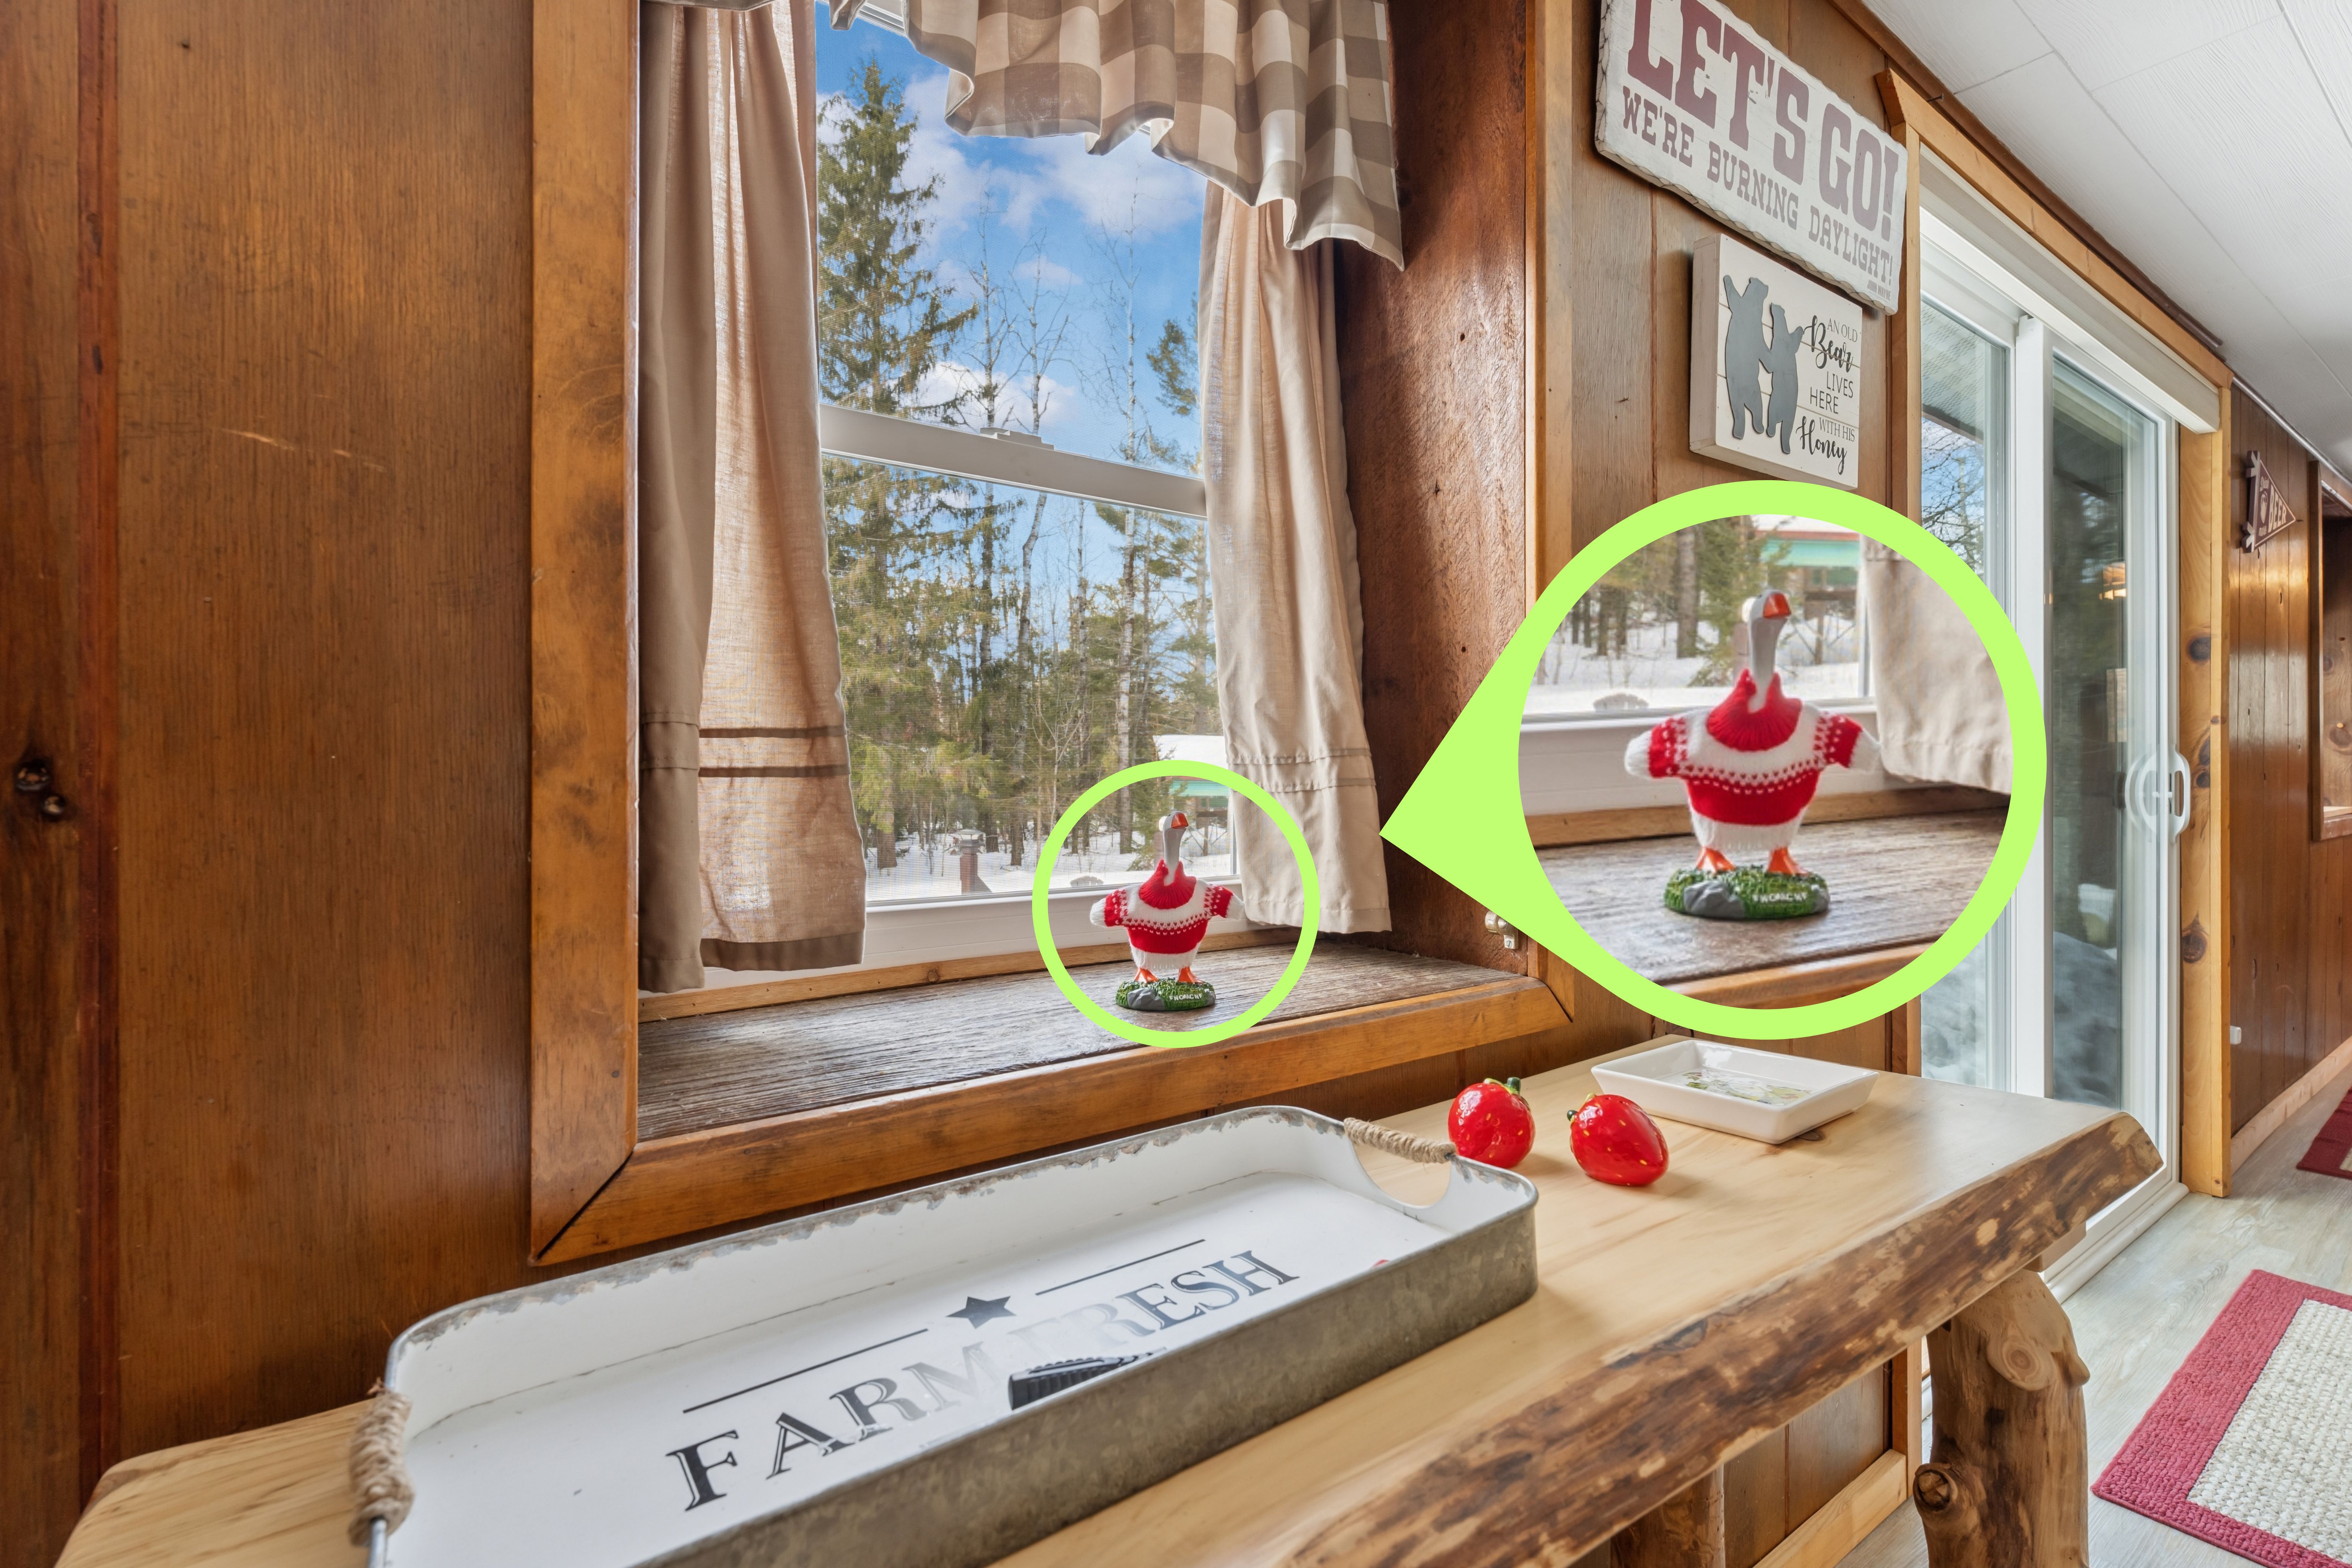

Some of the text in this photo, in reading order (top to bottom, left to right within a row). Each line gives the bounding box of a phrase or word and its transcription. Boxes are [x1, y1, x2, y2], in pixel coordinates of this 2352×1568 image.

[1628, 0, 1899, 242] LET'S GO!
[1623, 85, 1893, 286] WE'RE BURNING DAYLIGHT!
[1867, 279, 1891, 301] JOHN WAYNE
[1803, 315, 1853, 373] Bear
[1827, 318, 1858, 342] AN OLD
[1810, 387, 1838, 414] HERE
[1827, 371, 1853, 398] LIVES
[1796, 416, 1847, 475] Honey
[1819, 417, 1855, 442] WITH HIS
[2268, 484, 2287, 533] BEER
[665, 1341, 1003, 1512] FARM
